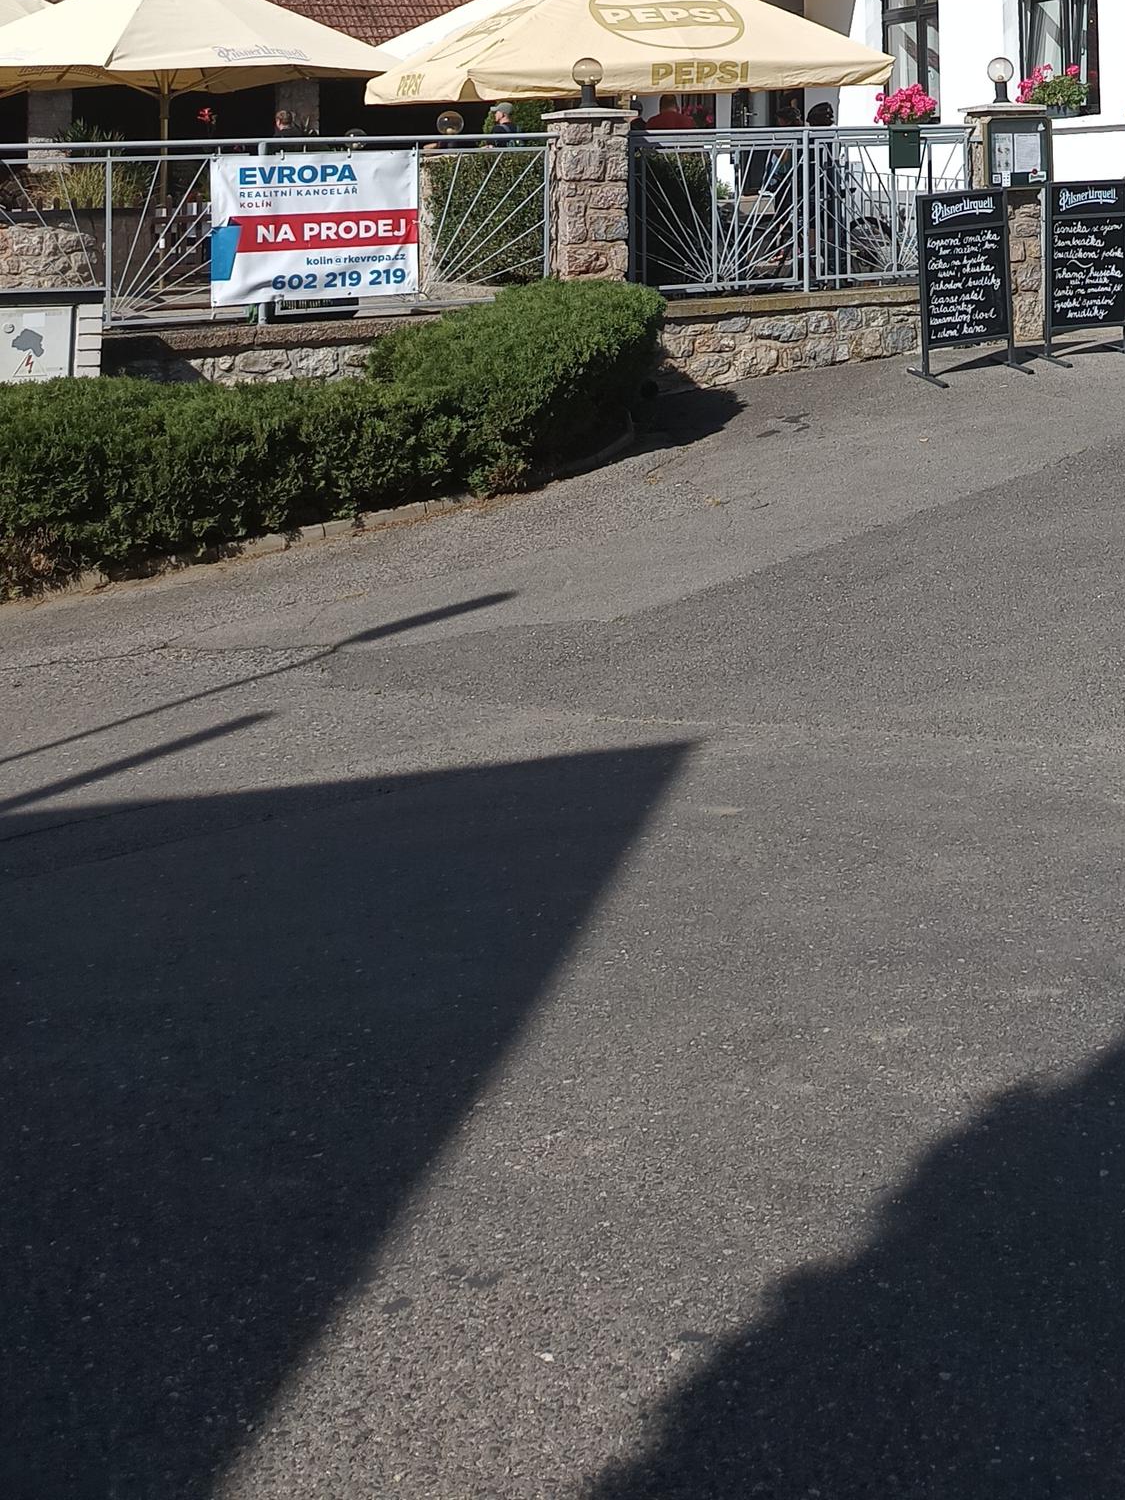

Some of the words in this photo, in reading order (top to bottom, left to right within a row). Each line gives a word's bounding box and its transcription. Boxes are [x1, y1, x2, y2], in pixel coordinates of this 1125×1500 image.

[598, 6, 735, 24] PEPSI
[396, 73, 425, 96] PEPSI
[651, 61, 749, 86] PEPSI
[239, 164, 358, 185] EVROPA
[239, 188, 292, 198] REALITNÍ
[296, 185, 358, 197] KANCELÁŘ
[1059, 188, 1089, 212] Pilsner
[1088, 186, 1116, 204] Urquell
[239, 200, 272, 209] KOLÍN
[931, 201, 963, 225] Pilsner
[962, 196, 993, 215] Urquell
[256, 223, 296, 243] NA
[303, 218, 406, 241] PRODEJ
[272, 273, 318, 290] 602
[324, 270, 362, 288] 219
[368, 267, 406, 286] 219
